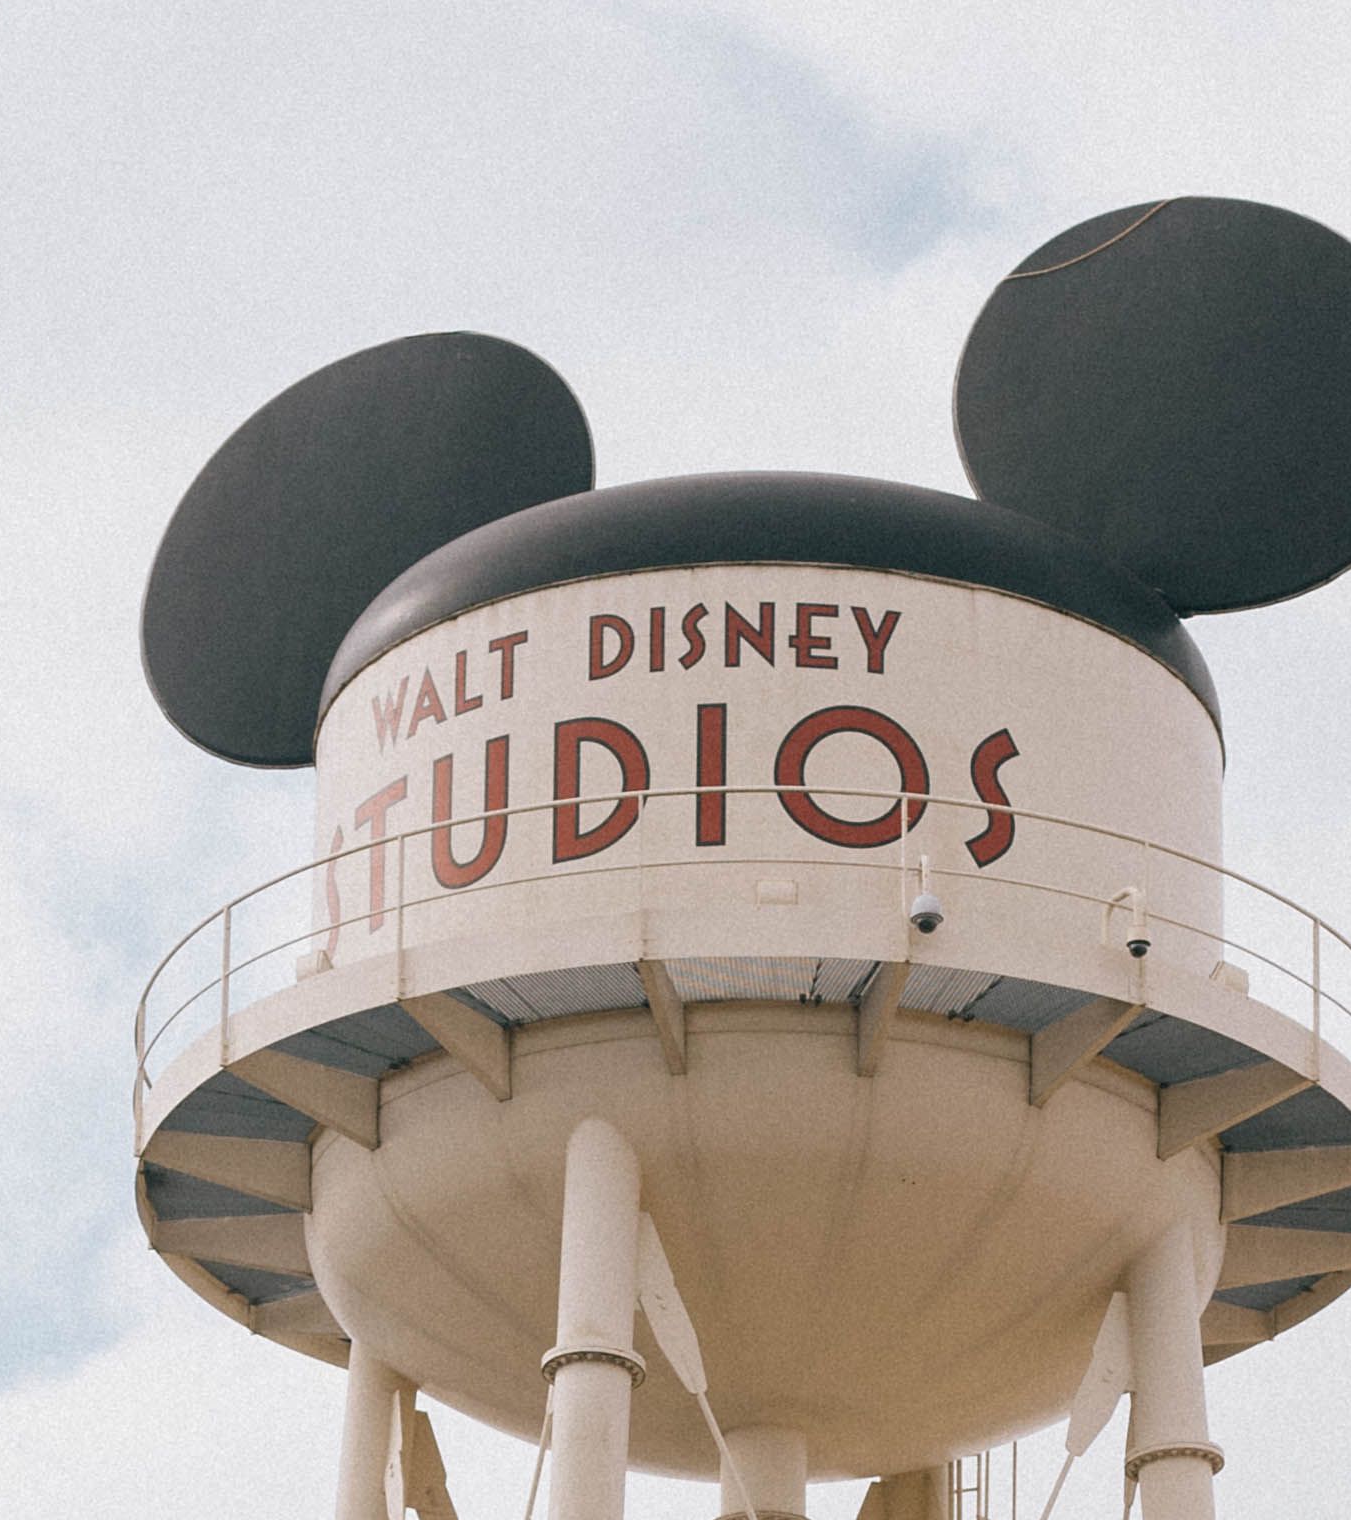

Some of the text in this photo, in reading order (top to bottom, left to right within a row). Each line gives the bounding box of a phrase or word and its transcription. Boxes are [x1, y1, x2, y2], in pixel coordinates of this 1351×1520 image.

[371, 600, 902, 756] WALT DISNEY
[324, 702, 1020, 962] STUDIOS
